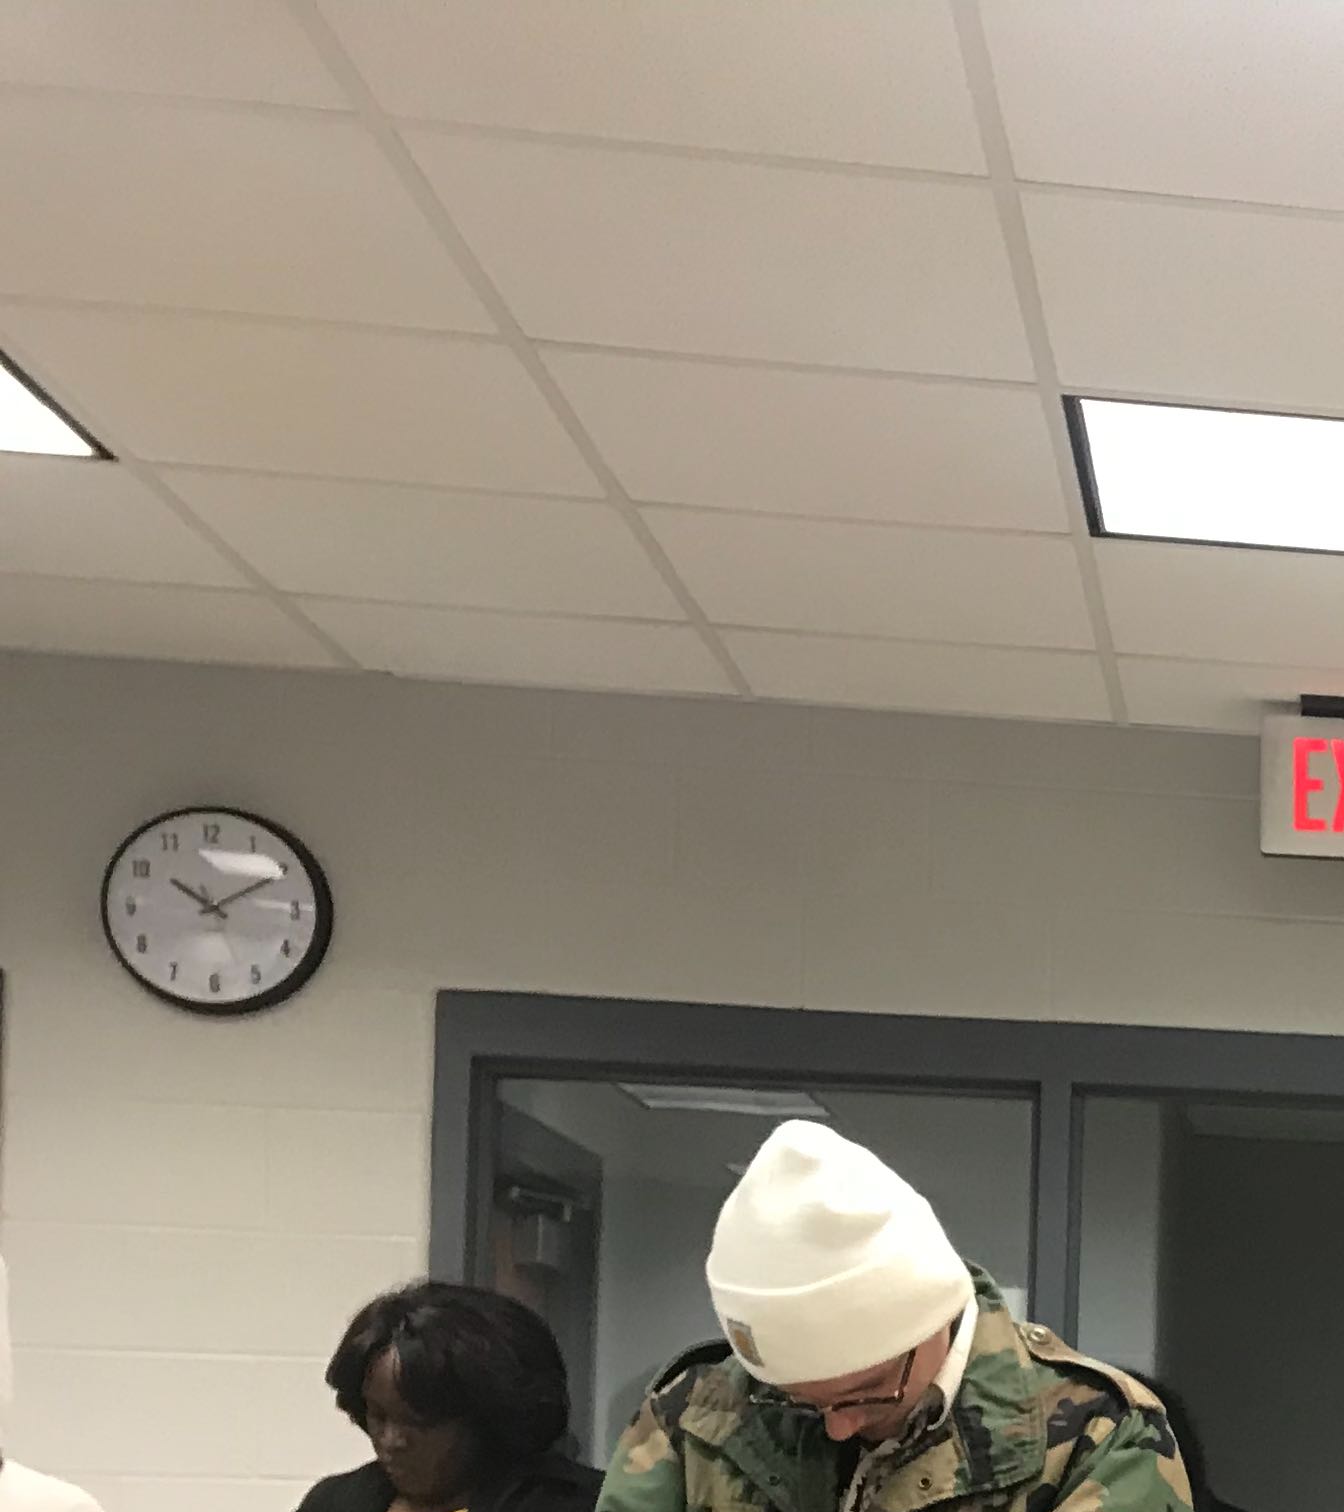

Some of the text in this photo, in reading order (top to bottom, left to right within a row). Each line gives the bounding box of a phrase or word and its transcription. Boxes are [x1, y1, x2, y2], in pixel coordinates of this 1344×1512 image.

[161, 833, 179, 851] 11
[203, 823, 220, 844] 12
[132, 860, 151, 879] 10
